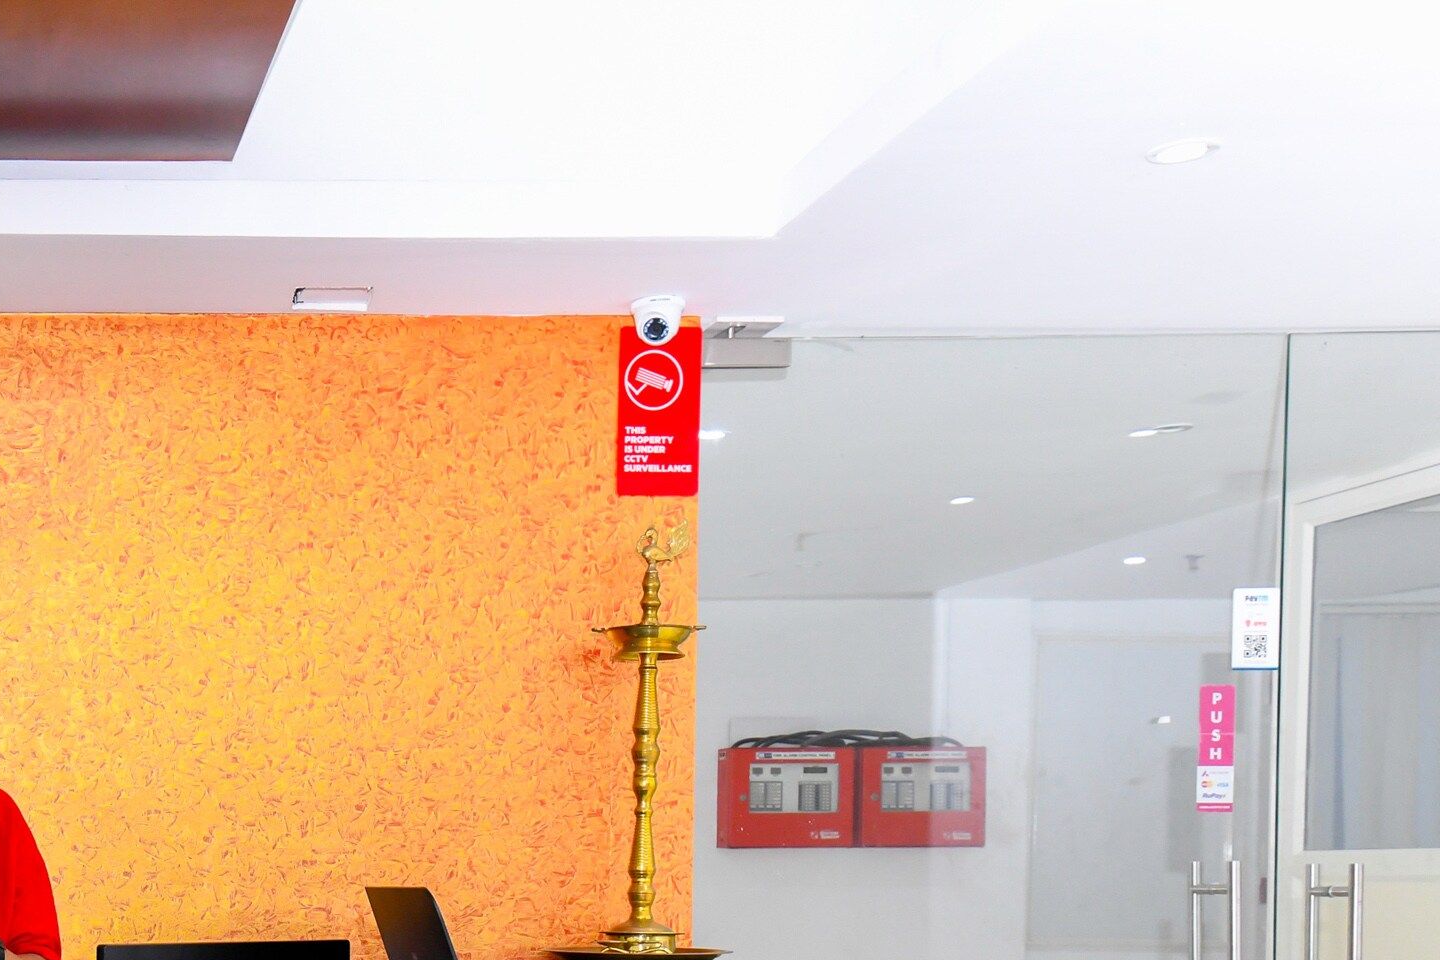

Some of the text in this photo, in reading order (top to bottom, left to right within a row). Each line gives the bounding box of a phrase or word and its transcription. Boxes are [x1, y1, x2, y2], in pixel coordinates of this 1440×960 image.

[624, 426, 646, 434] THIS
[624, 436, 674, 444] PROPERTY
[624, 445, 666, 454] IS UNDER
[624, 455, 649, 463] CCTV
[623, 464, 692, 473] SURVEILLANCE
[1209, 692, 1223, 760] PUSH
